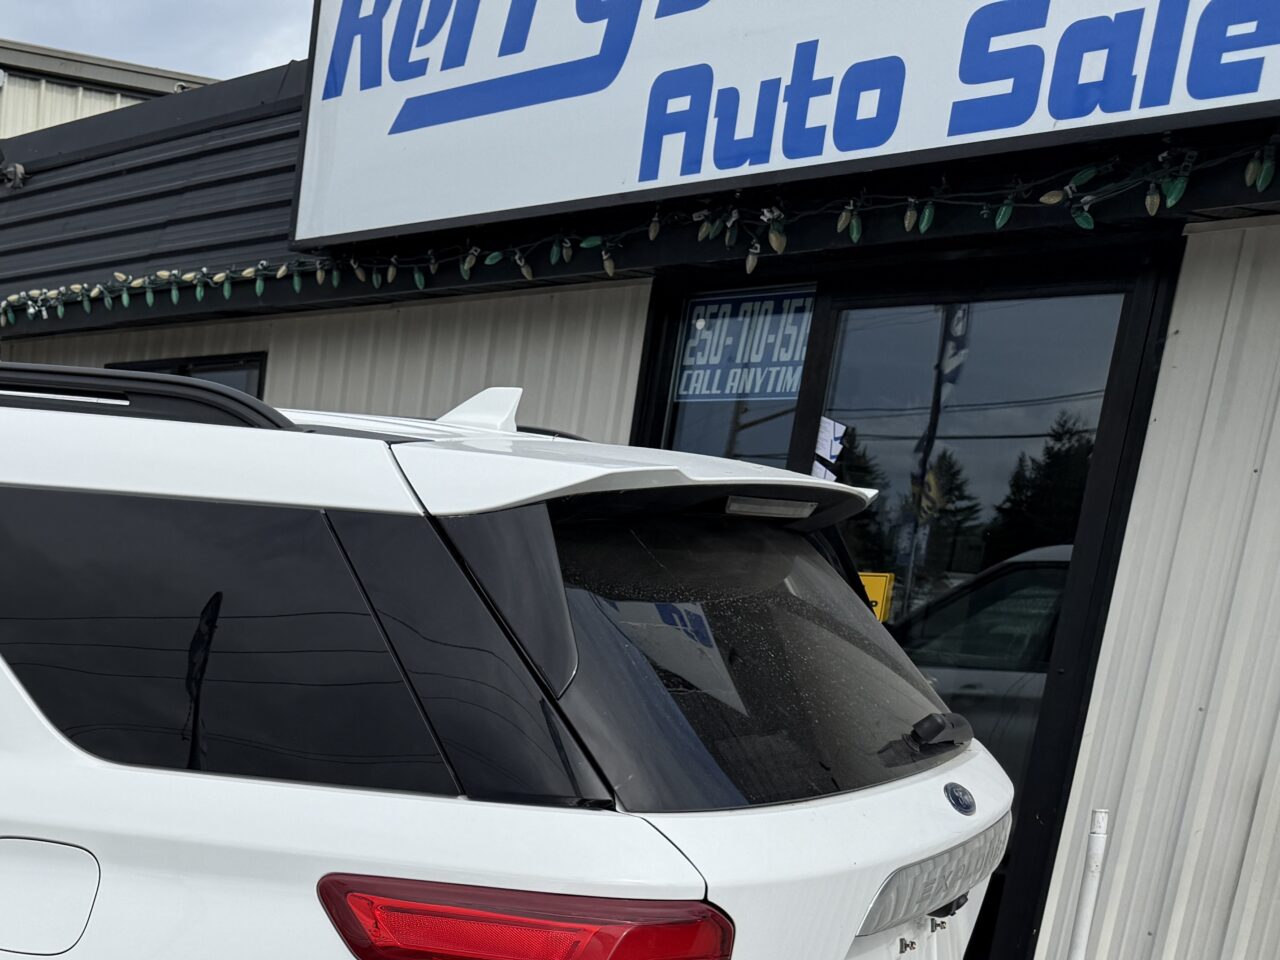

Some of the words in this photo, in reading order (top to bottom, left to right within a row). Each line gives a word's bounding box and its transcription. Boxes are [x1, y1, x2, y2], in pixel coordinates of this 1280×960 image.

[638, 39, 906, 182] Auto
[682, 297, 813, 366] 250-710-151
[678, 369, 722, 395] CALL
